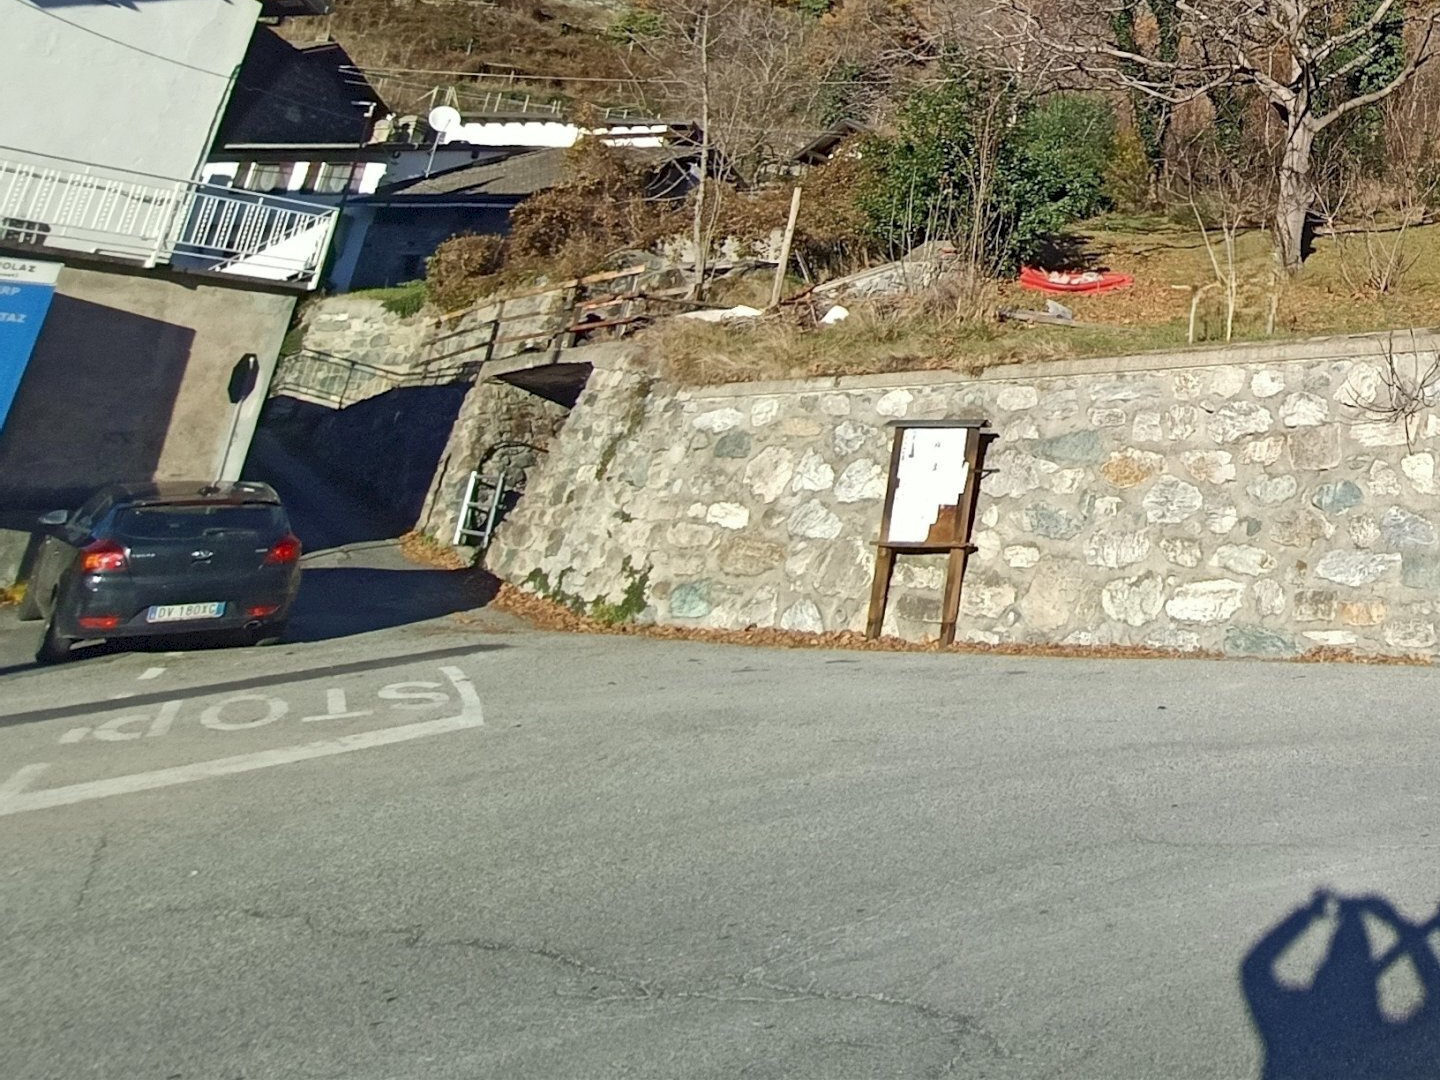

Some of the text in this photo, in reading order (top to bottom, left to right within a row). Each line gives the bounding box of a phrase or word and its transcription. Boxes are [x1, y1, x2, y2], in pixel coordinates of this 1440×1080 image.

[0, 262, 36, 272] OLAZ
[158, 607, 174, 618] DV
[93, 681, 450, 742] STOP
